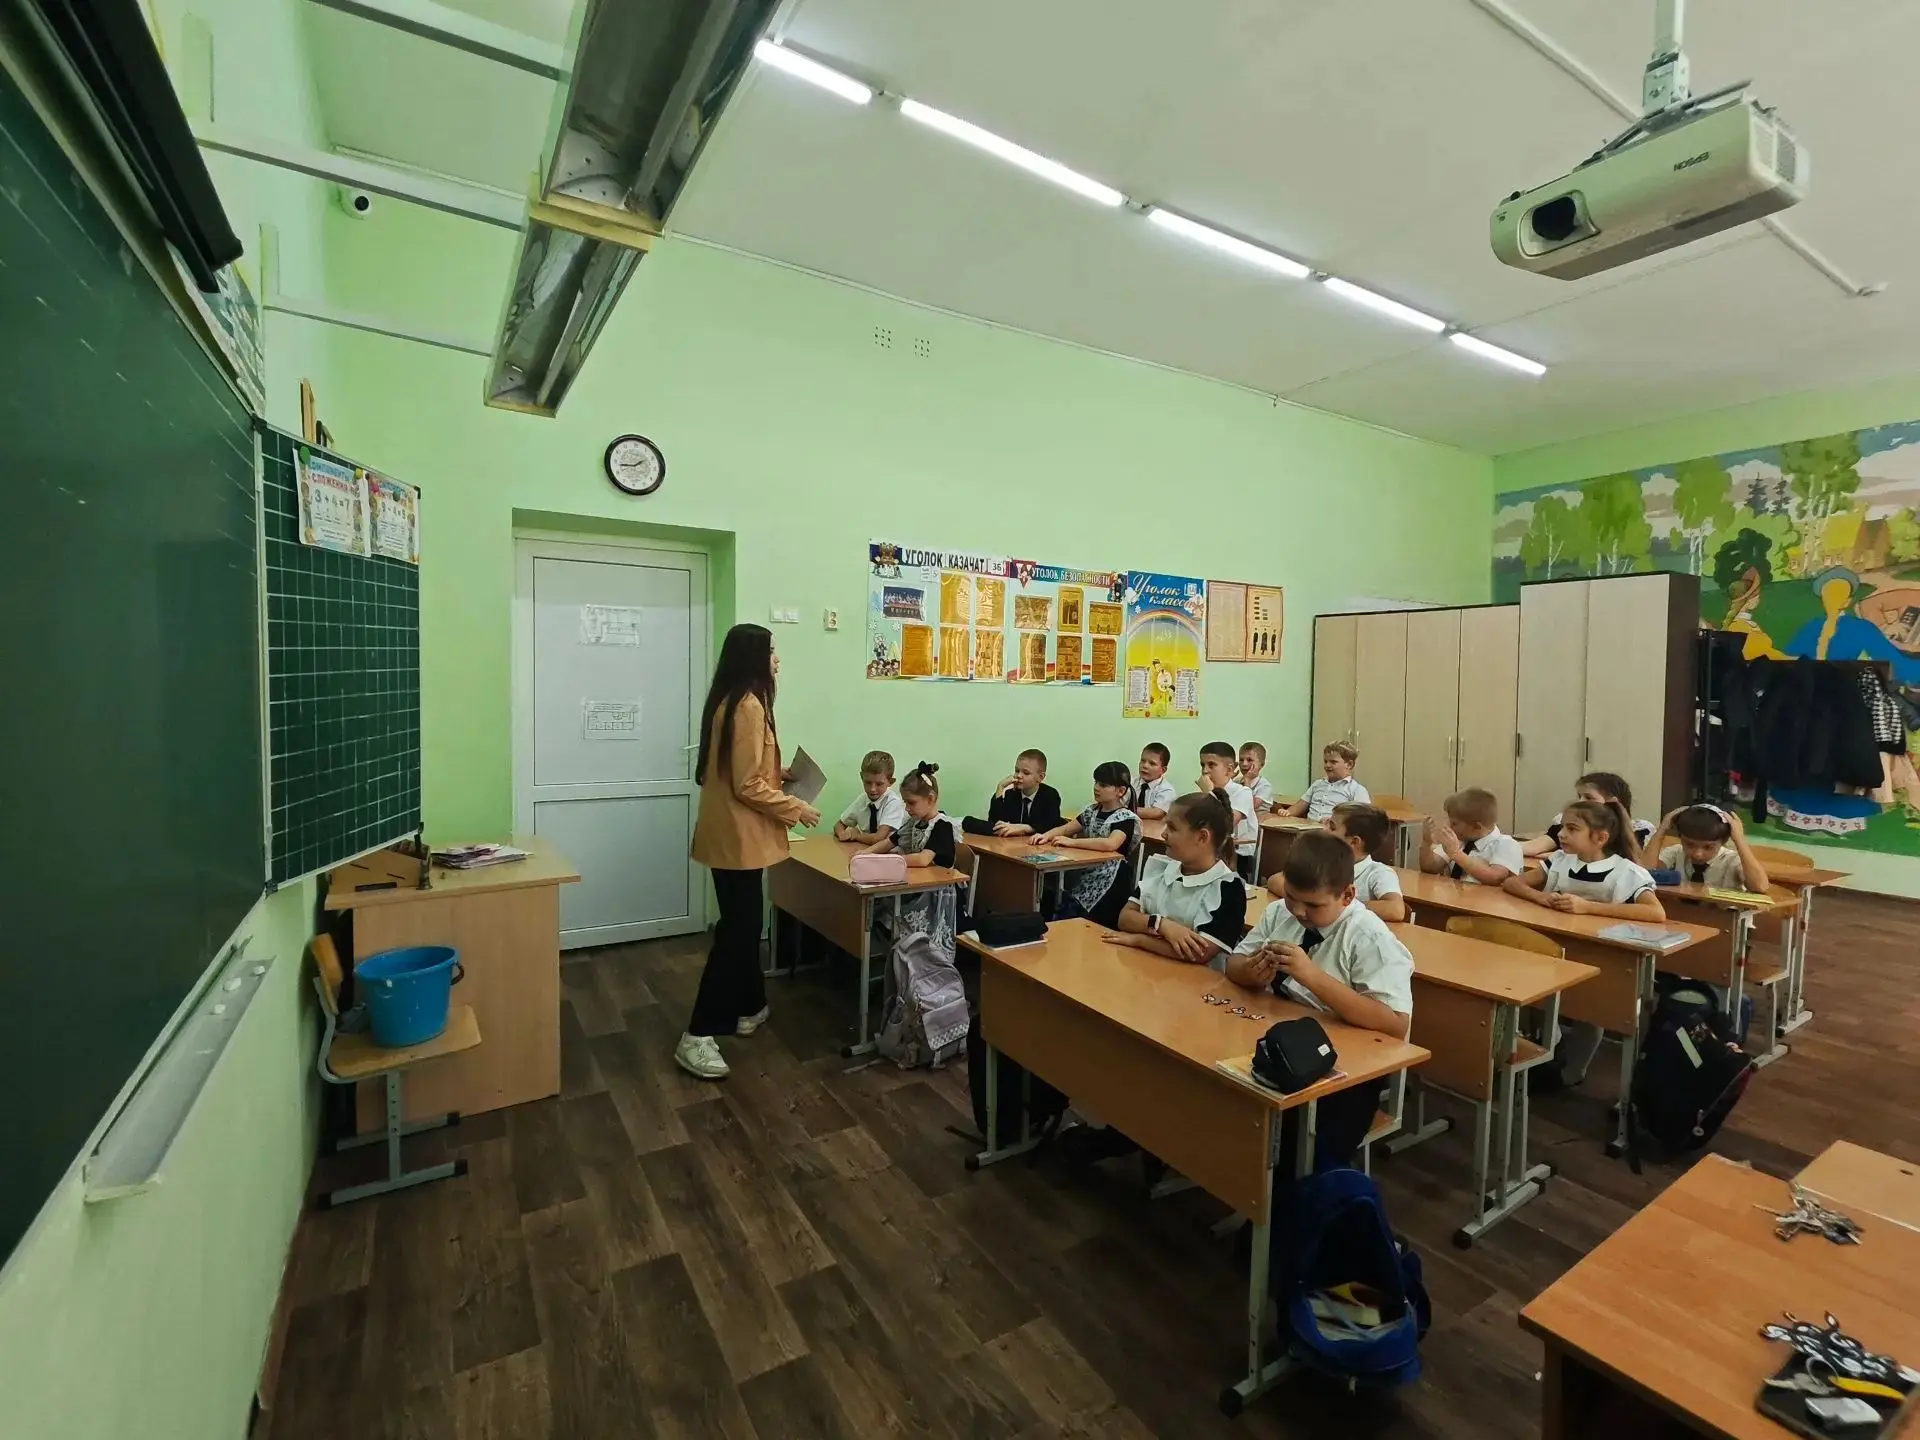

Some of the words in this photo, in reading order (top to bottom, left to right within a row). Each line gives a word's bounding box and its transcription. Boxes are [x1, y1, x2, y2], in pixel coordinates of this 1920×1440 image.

[1673, 151, 1709, 172] EPSON
[905, 549, 943, 568] УГОЛОК
[948, 553, 985, 573] КАЗАЧАТ
[1031, 567, 1059, 581] УГОЛОК
[1060, 569, 1111, 586] БЕЗОПАСНОСТИ
[1132, 573, 1181, 602] Уголок
